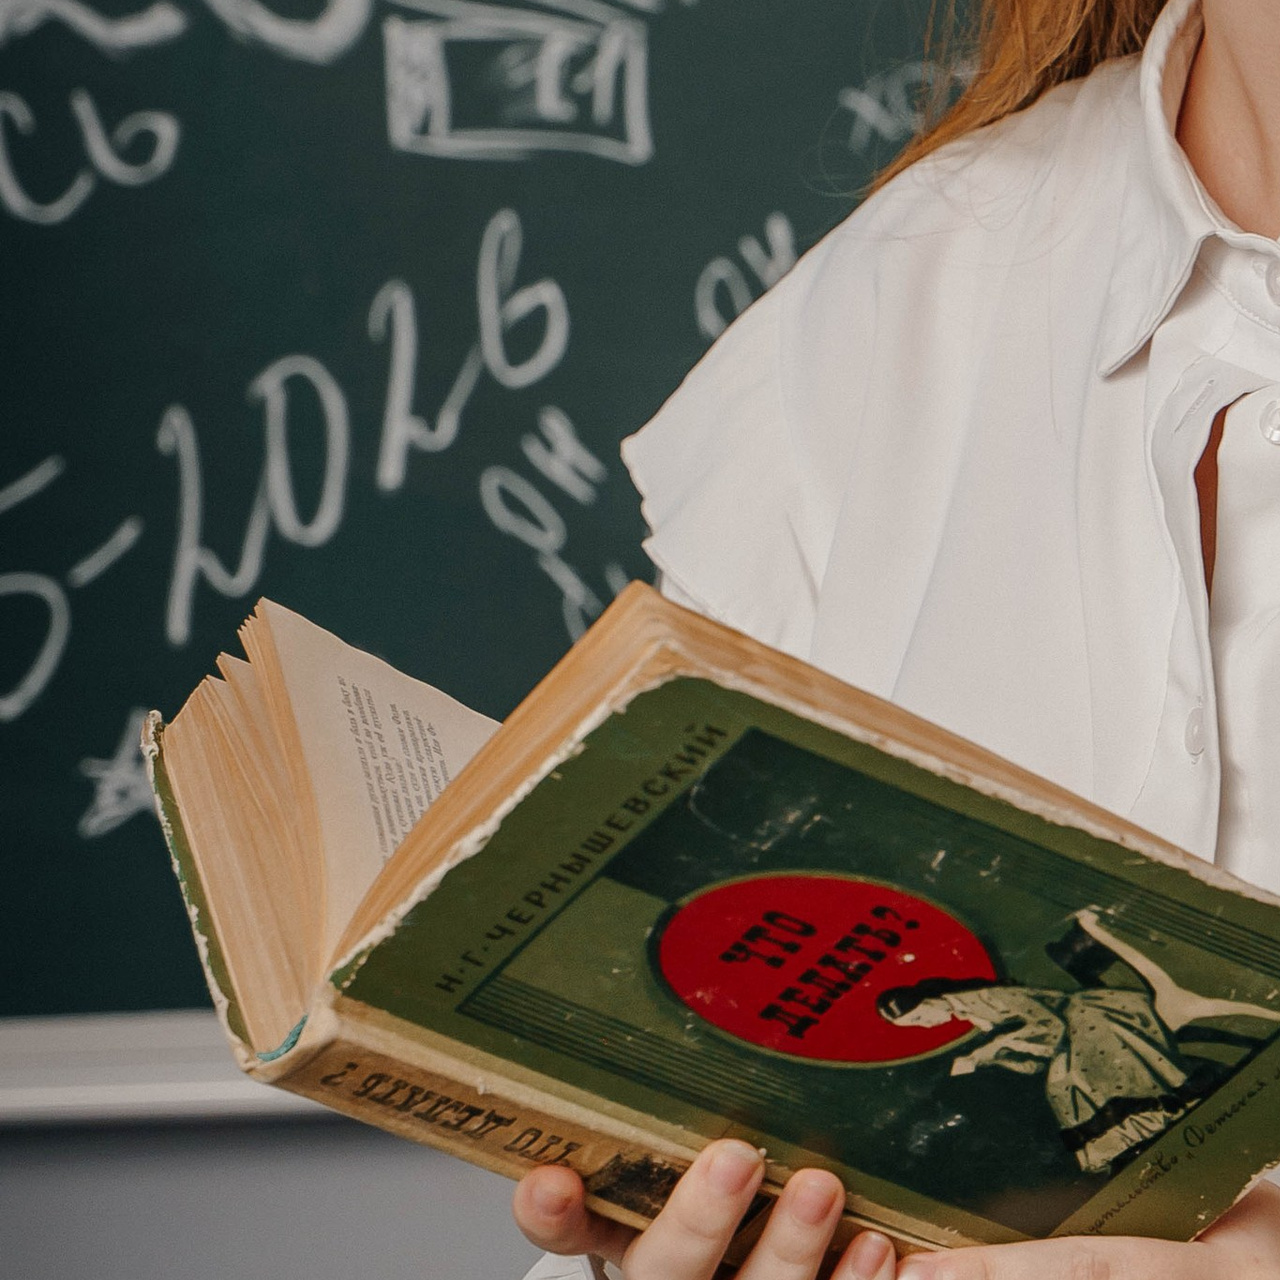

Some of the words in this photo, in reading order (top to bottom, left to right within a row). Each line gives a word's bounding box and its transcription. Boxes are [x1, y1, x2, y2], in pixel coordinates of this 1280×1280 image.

[485, 723, 729, 943] ЧЕРНЫШЕВСКИЙ
[718, 910, 818, 970] ЧТО
[758, 905, 921, 1040] ДЕЛАТЬ?
